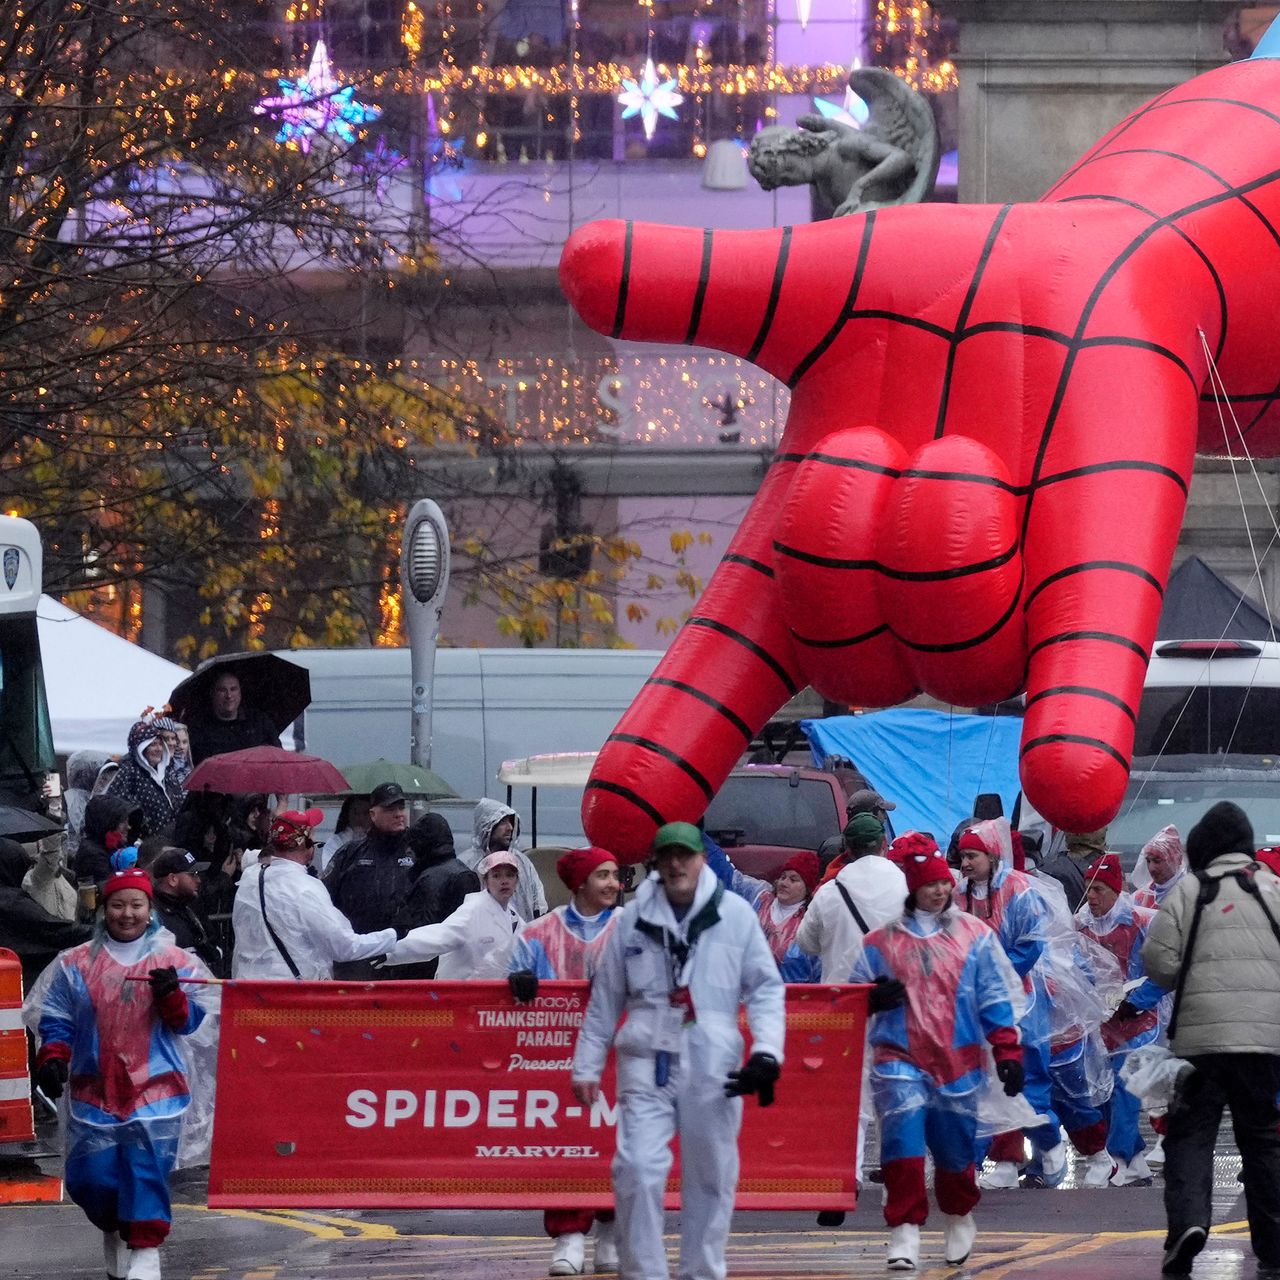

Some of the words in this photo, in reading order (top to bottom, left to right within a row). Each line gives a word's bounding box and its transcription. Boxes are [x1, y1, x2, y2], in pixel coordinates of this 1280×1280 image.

[526, 992, 581, 1011] macy's
[477, 1010, 583, 1027] THANKSGIVING
[516, 1030, 573, 1046] PARADE
[345, 1089, 619, 1128] SPIDER-M
[475, 1145, 600, 1158] MARVEL
